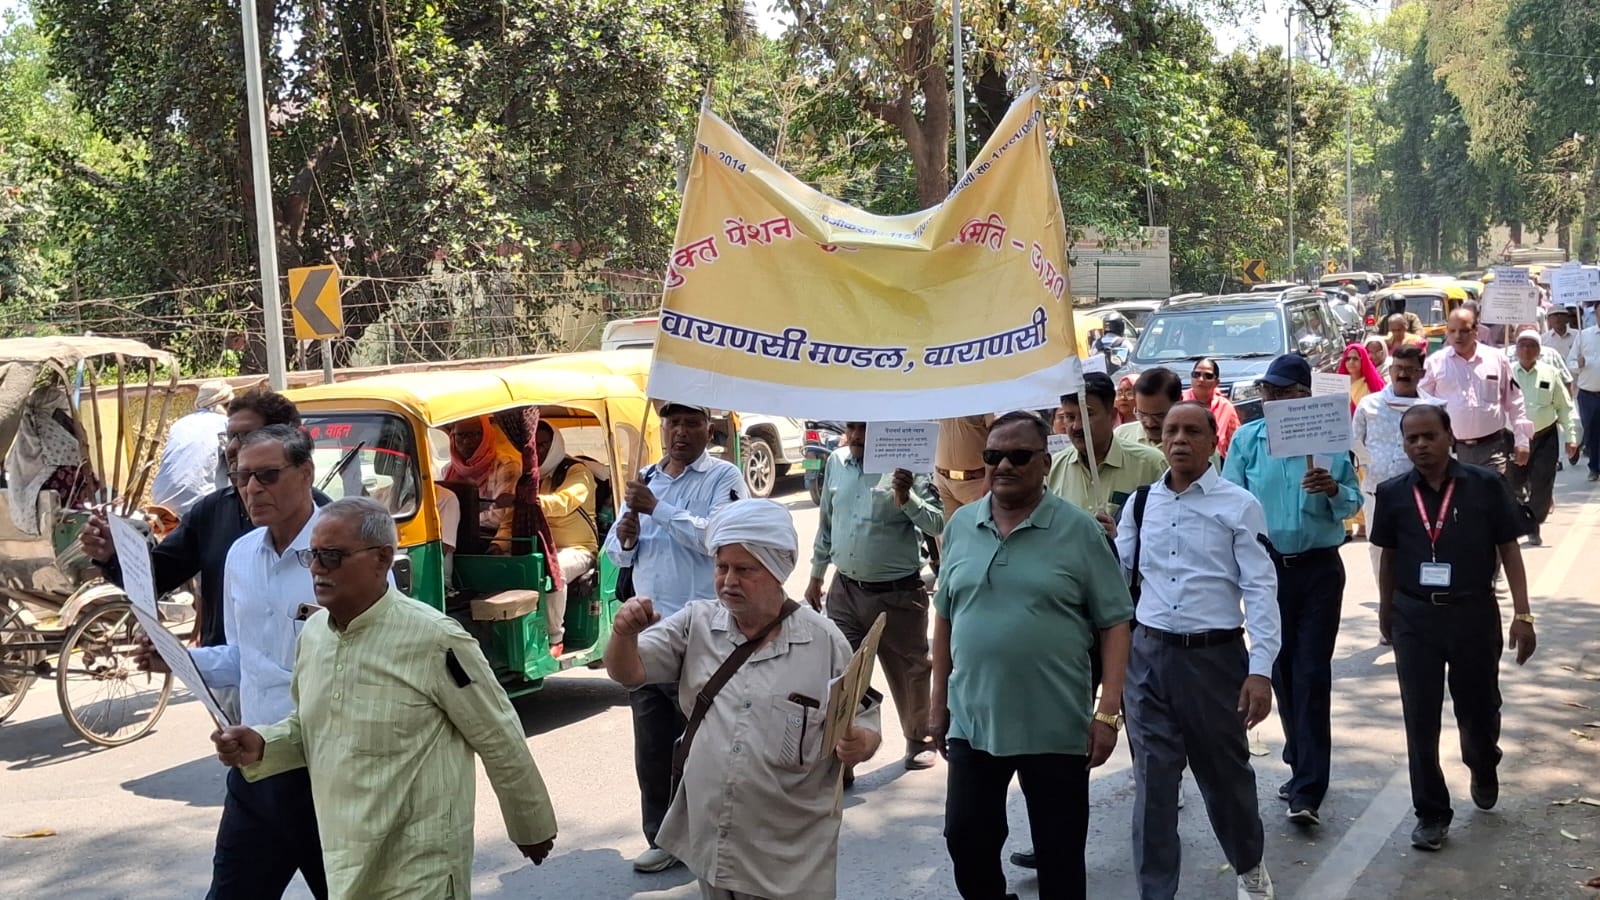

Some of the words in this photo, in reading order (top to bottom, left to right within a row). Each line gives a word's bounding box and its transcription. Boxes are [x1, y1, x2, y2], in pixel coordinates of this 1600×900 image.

[719, 152, 747, 173] 2014
[661, 310, 807, 361] वाराणसी
[808, 341, 915, 373] मण्डल,
[924, 305, 1048, 367] वाराणसी
[325, 423, 353, 439] वाहन
